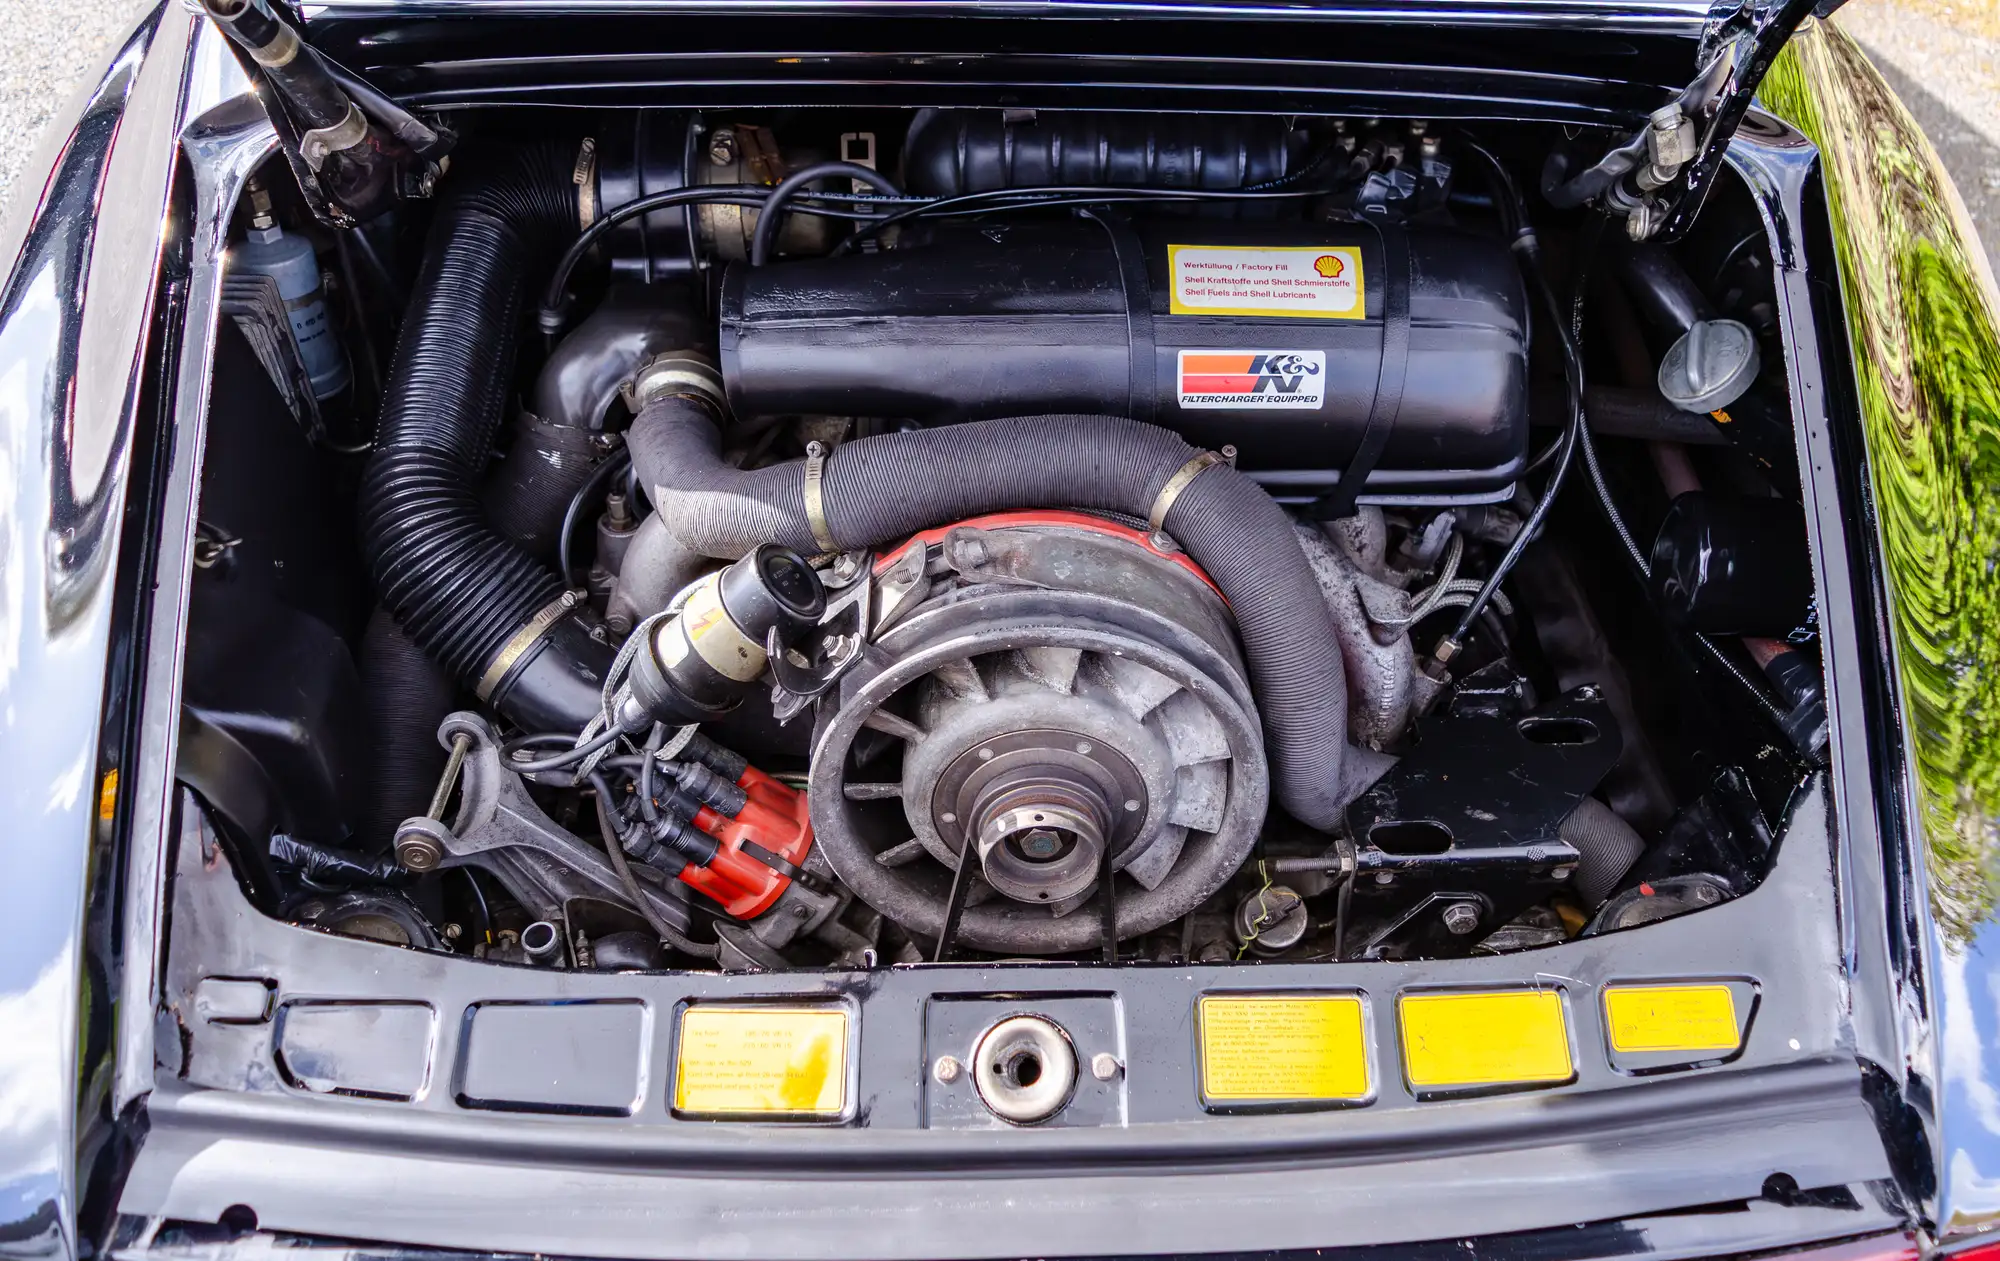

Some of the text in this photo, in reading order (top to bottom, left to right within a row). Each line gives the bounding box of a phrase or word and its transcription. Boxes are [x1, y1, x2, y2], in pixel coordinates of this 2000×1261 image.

[1241, 263, 1273, 272] Factory
[1184, 276, 1205, 284] Shell
[1207, 277, 1251, 285] Kraftstoffe
[1271, 278, 1293, 286] Shell
[1294, 279, 1351, 287] Schmierstoffe
[1185, 288, 1206, 296] Shell
[1207, 289, 1230, 297] Fuels
[1250, 290, 1271, 298] Shell
[1273, 291, 1317, 299] Lubricants
[1266, 395, 1318, 403] EQUIPPED
